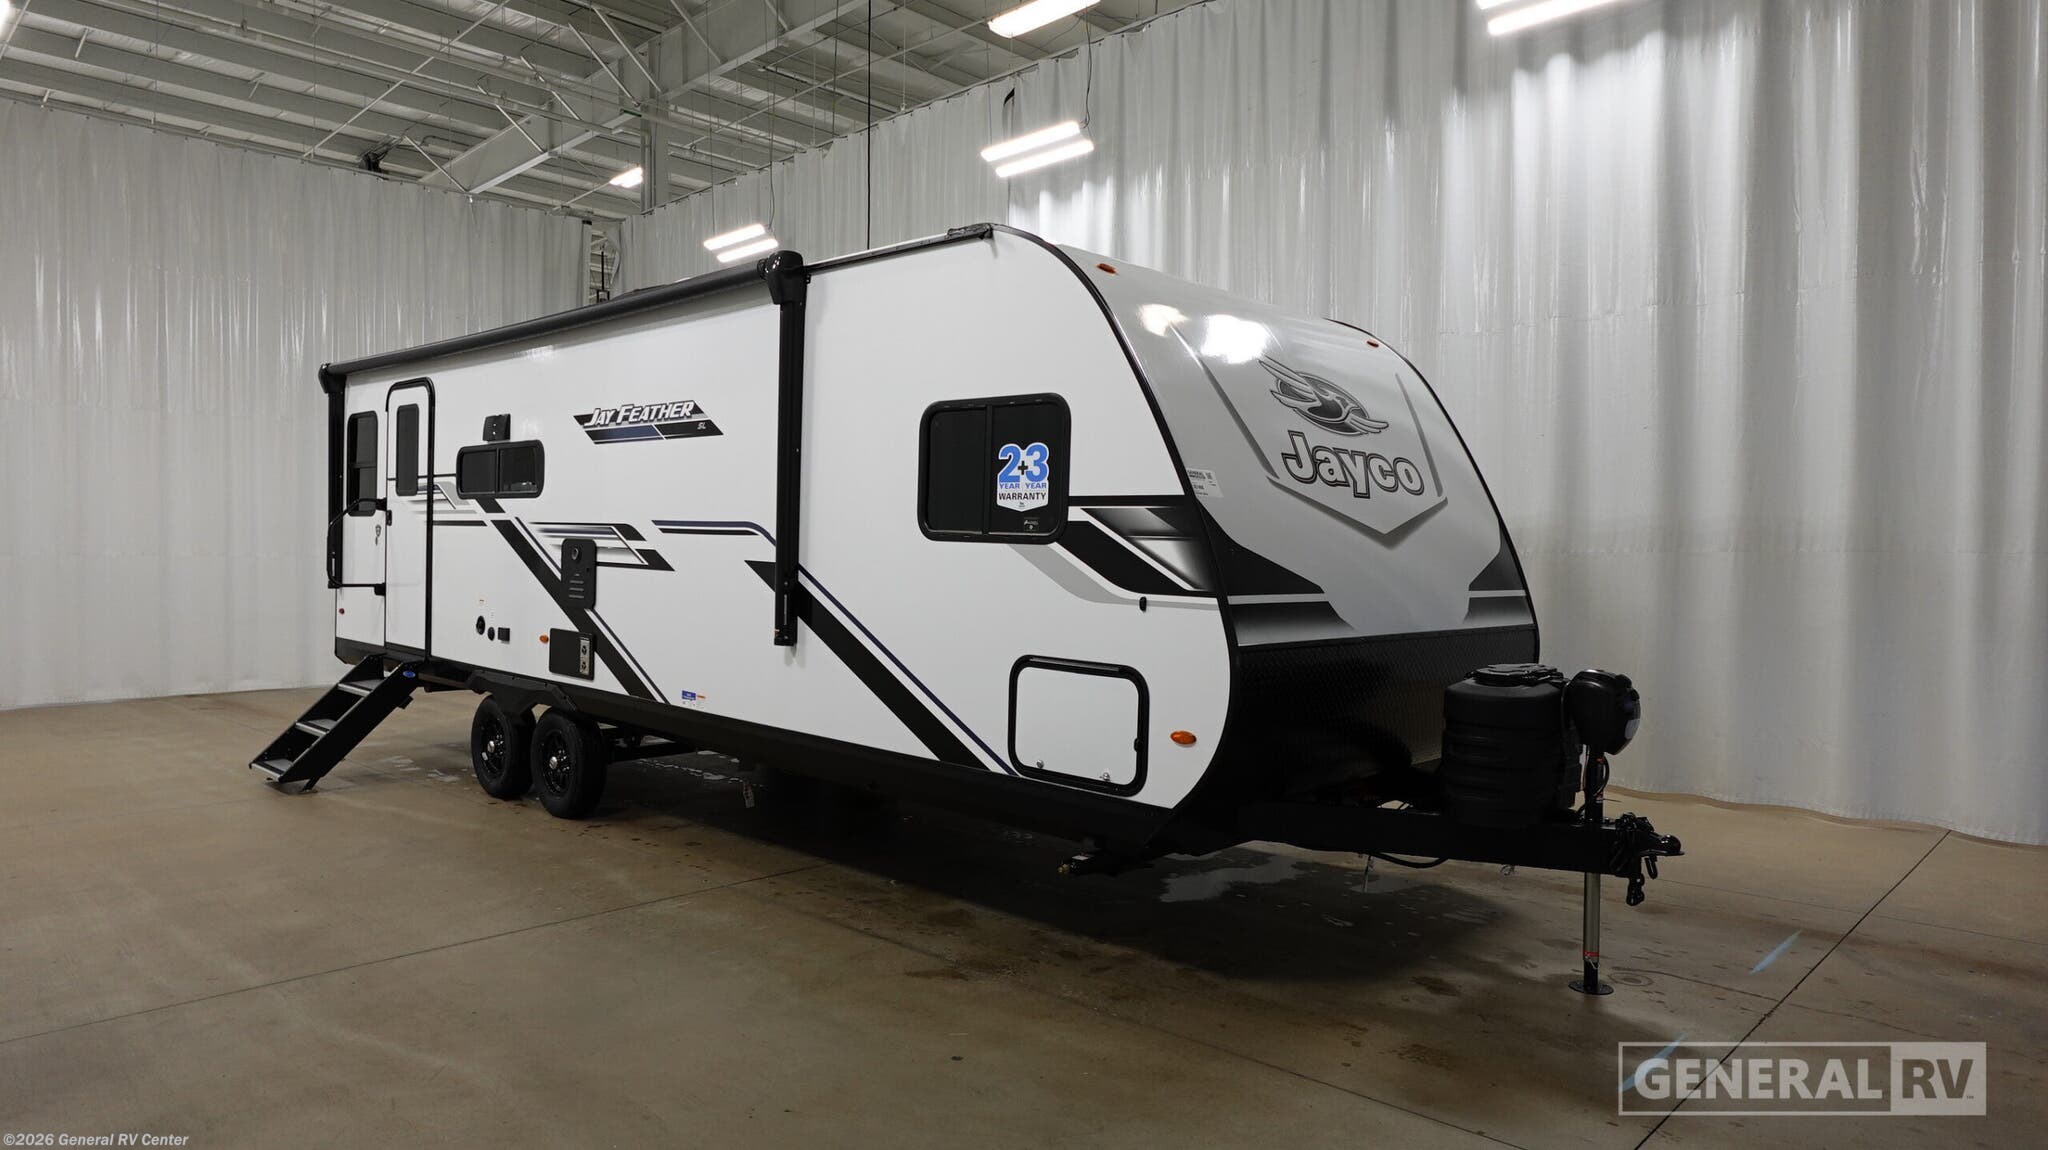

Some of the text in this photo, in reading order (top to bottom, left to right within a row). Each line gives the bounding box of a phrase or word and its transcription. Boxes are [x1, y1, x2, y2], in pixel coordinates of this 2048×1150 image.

[583, 400, 695, 429] JAY FEATHER
[1281, 430, 1425, 499] Jayco
[998, 492, 1046, 501] WARRANTY
